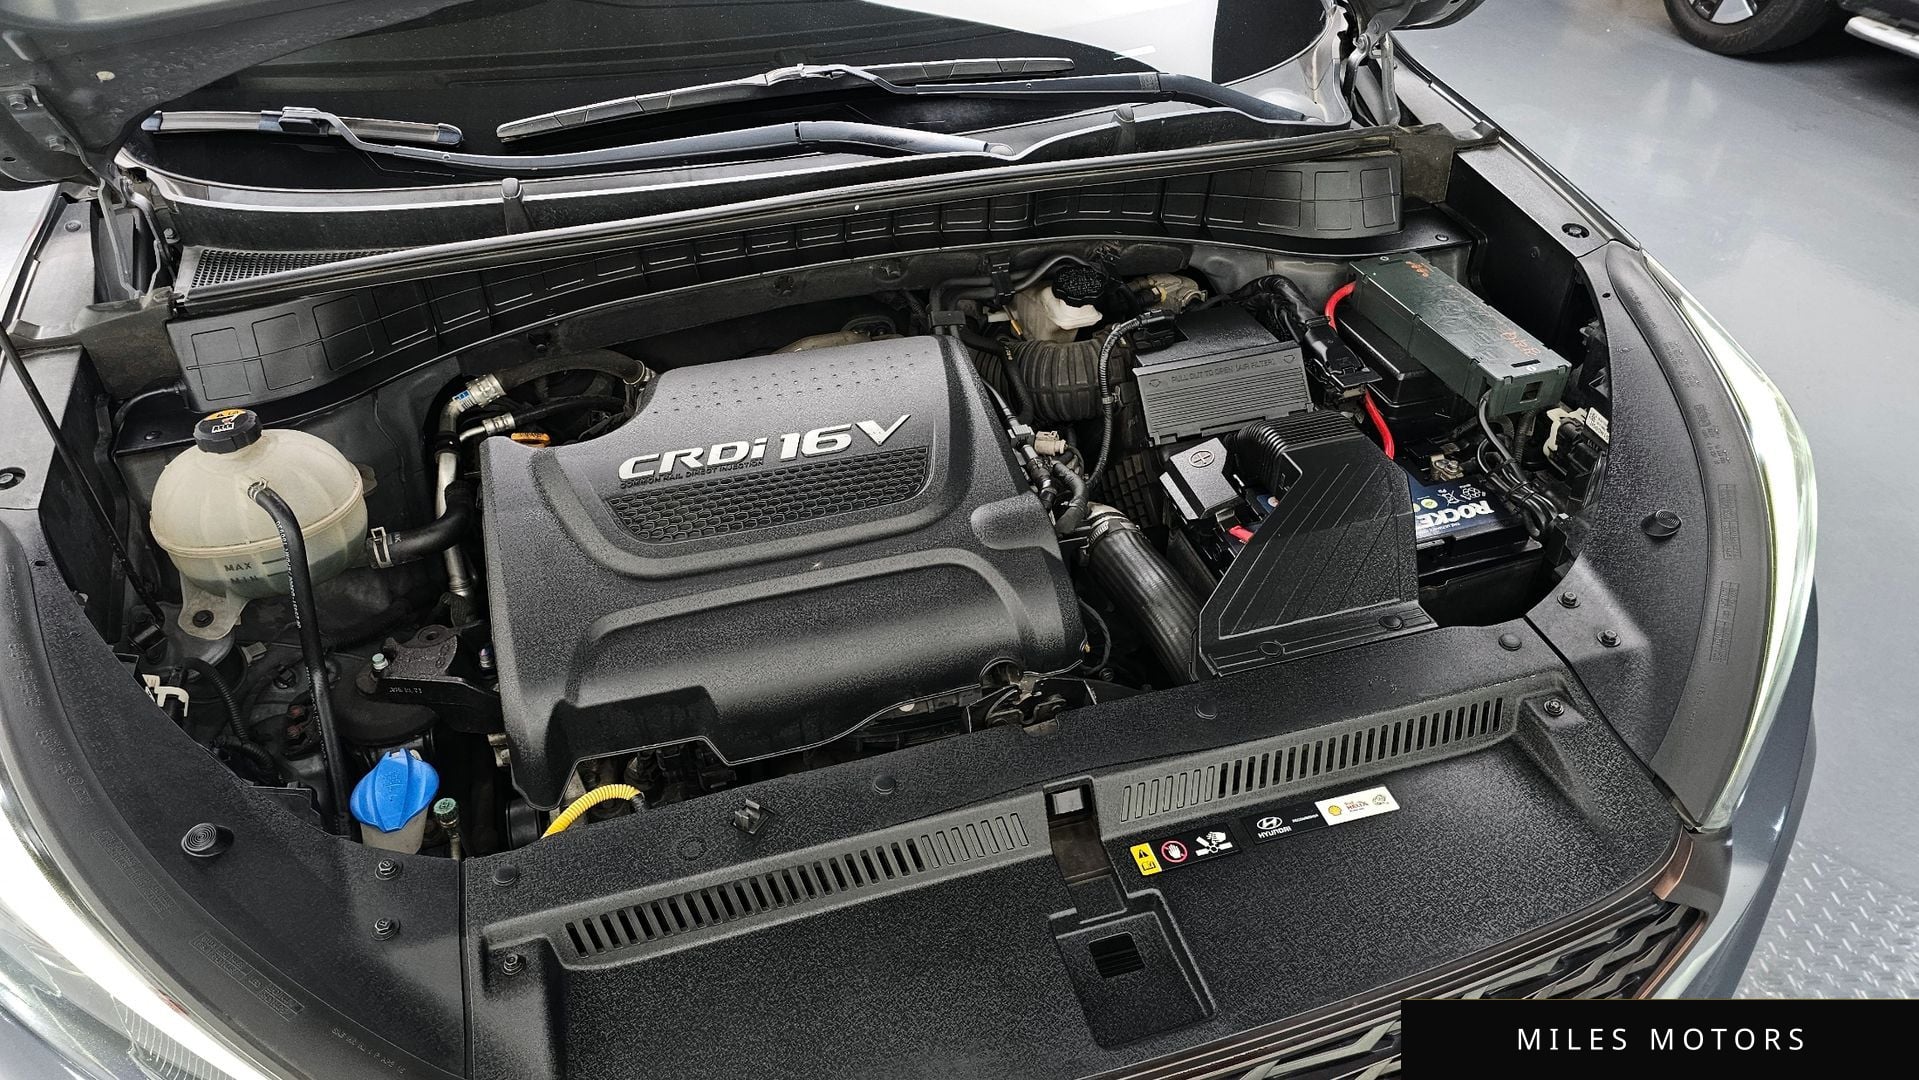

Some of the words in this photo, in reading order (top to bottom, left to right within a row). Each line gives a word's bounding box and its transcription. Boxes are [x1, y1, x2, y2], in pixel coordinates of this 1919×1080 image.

[1171, 373, 1189, 384] PULL
[1190, 371, 1203, 380] OUT
[1205, 369, 1214, 378] TO
[1215, 366, 1234, 376] OPEN
[618, 437, 768, 480] CRDi
[780, 414, 912, 462] 16V
[685, 465, 718, 478] DIRECT
[719, 459, 765, 473] INJECTION
[224, 562, 252, 572] MAX
[1257, 825, 1293, 839] HYUNDAI
